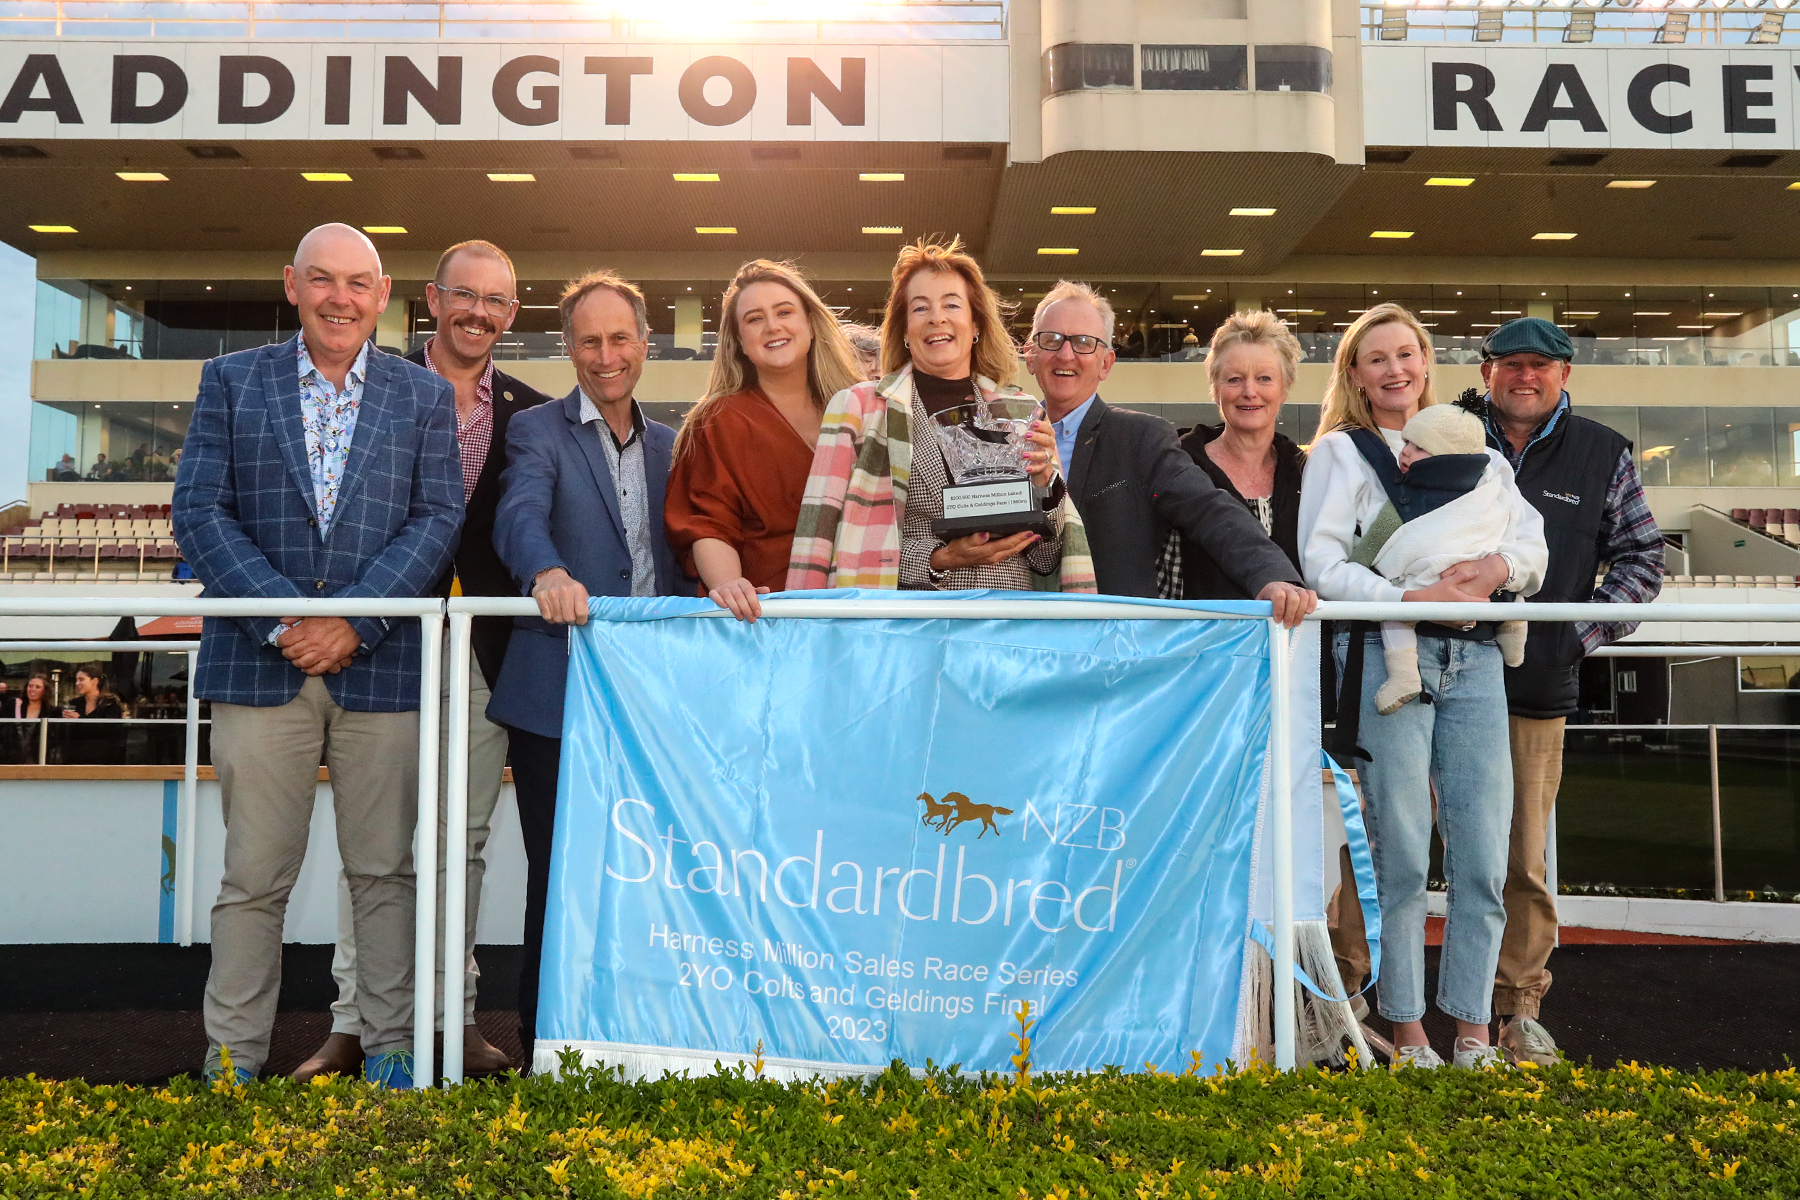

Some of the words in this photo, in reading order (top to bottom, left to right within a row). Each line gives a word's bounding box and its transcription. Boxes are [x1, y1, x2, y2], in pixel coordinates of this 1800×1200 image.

[0, 54, 866, 127] ADDINGTON
[1432, 62, 1800, 135] RACE
[1022, 798, 1126, 851] NZB
[649, 922, 755, 960] Harness
[764, 937, 835, 970] Million
[844, 950, 915, 978] Sales
[923, 956, 989, 982] Race
[998, 961, 1079, 987] Series
[678, 962, 733, 991] 2YO
[743, 970, 805, 1000] Colts
[809, 983, 855, 1006] and
[865, 986, 974, 1019] Geldings
[984, 992, 1046, 1017] Final
[826, 1015, 888, 1043] 2023
